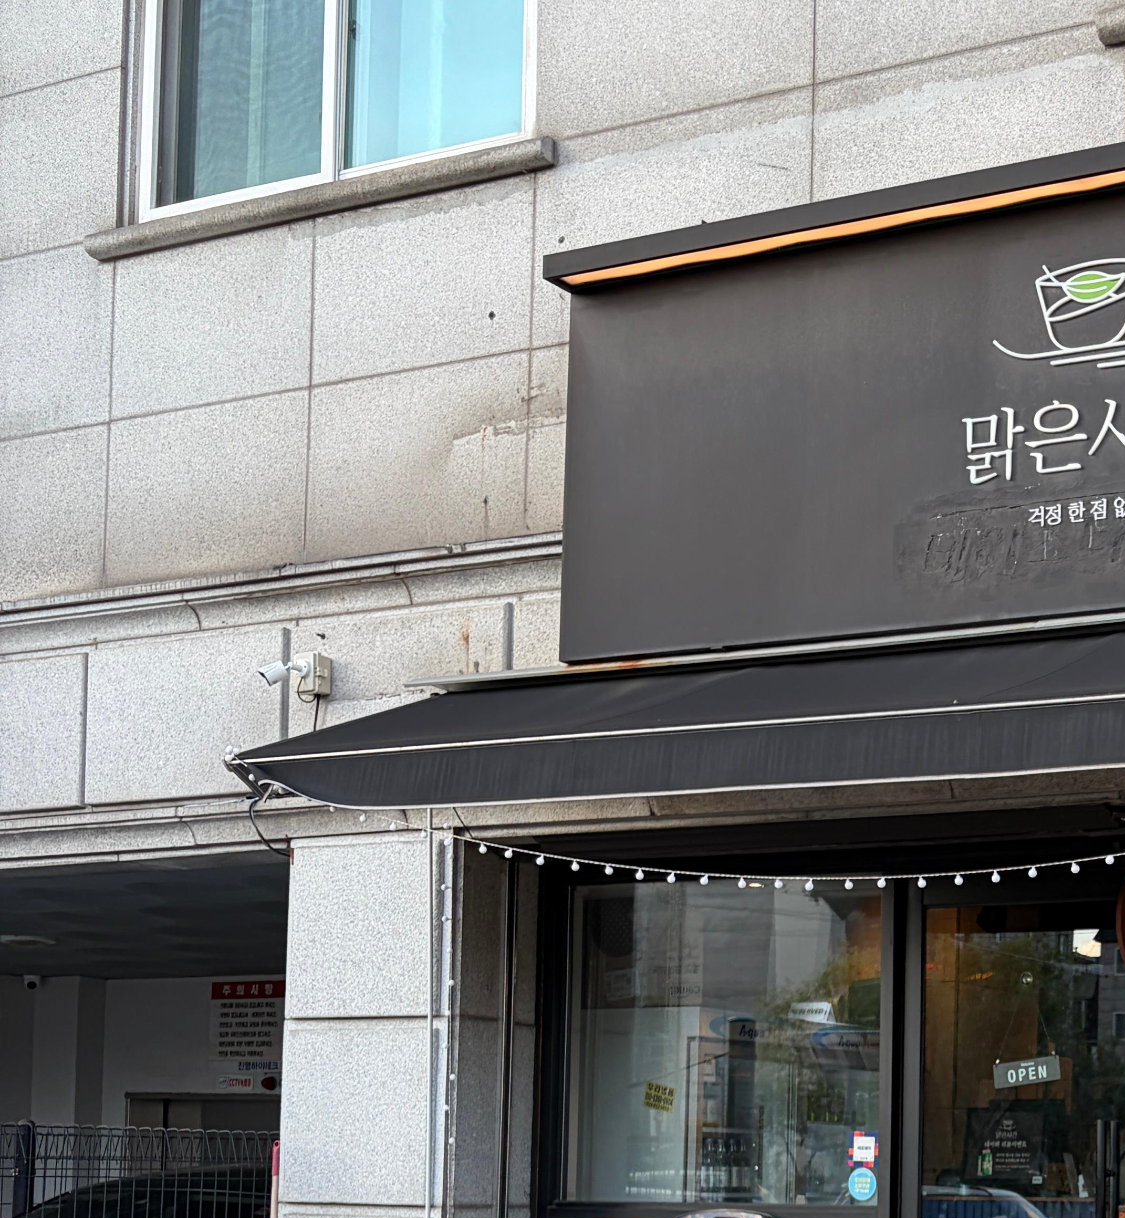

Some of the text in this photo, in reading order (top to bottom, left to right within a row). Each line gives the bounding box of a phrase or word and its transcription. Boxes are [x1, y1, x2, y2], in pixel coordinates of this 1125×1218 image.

[1028, 503, 1062, 528] 걱정
[1067, 500, 1087, 523] 한
[1089, 498, 1108, 521] 점
[1007, 1064, 1047, 1083] OPEN
